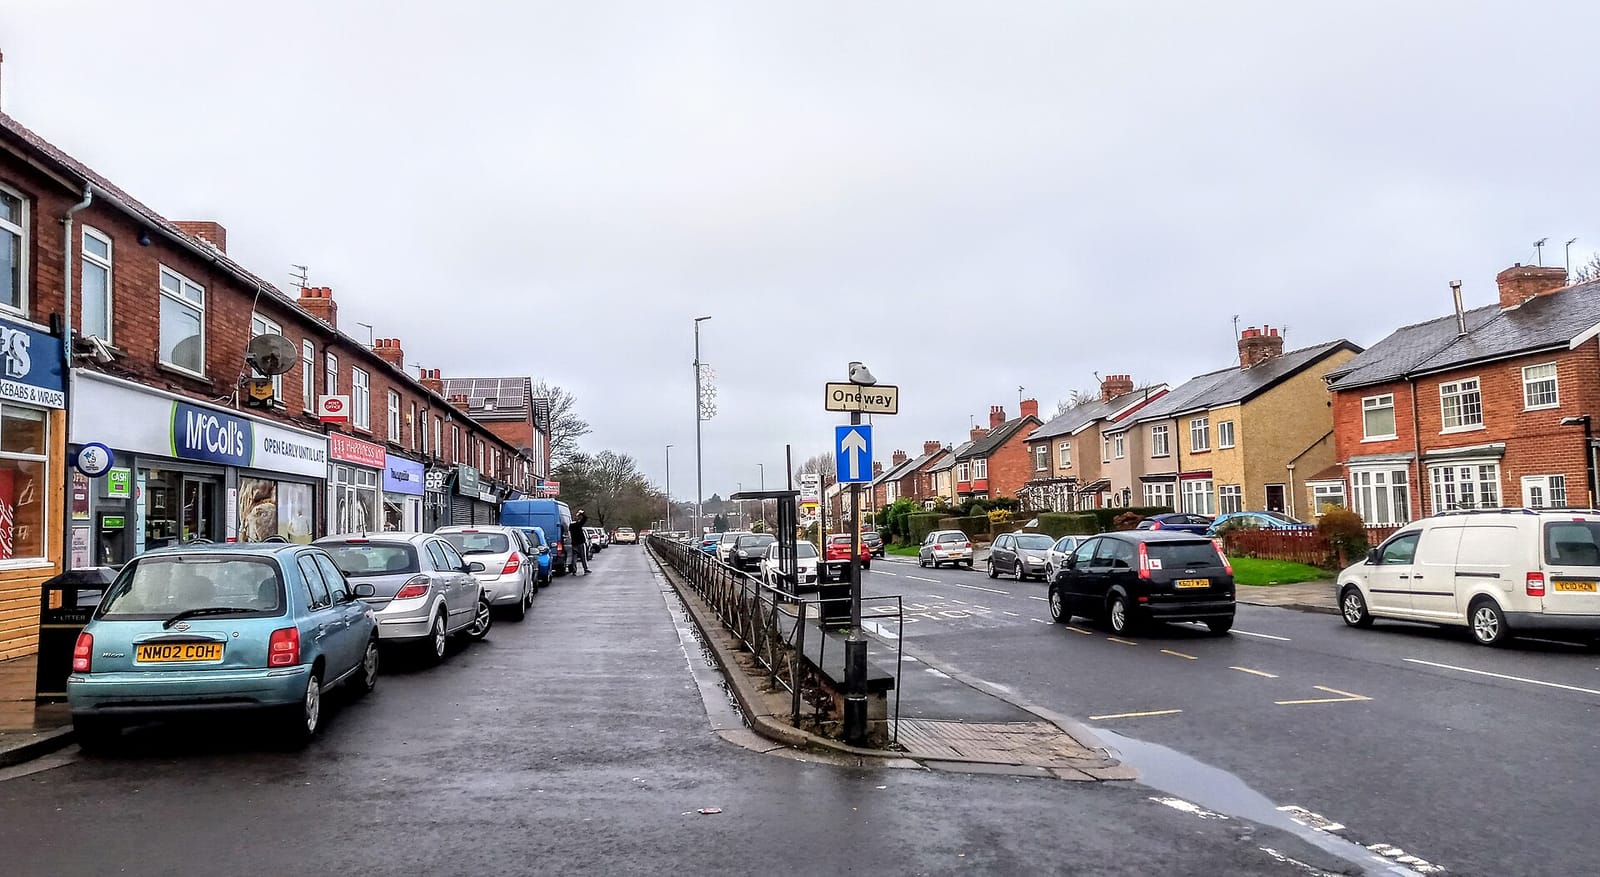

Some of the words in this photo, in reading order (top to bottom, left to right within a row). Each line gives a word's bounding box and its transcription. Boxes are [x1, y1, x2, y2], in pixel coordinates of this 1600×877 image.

[30, 388, 36, 400] &
[38, 391, 63, 406] WRAPS
[186, 411, 244, 457] McColl's
[264, 437, 281, 454] OPEN
[281, 440, 298, 458] EARLY
[298, 444, 313, 461] UNTIL
[313, 448, 325, 463] LATE
[111, 472, 127, 482] CASH
[1151, 560, 1159, 568] L
[142, 645, 181, 659] NM02
[185, 645, 215, 658] COH
